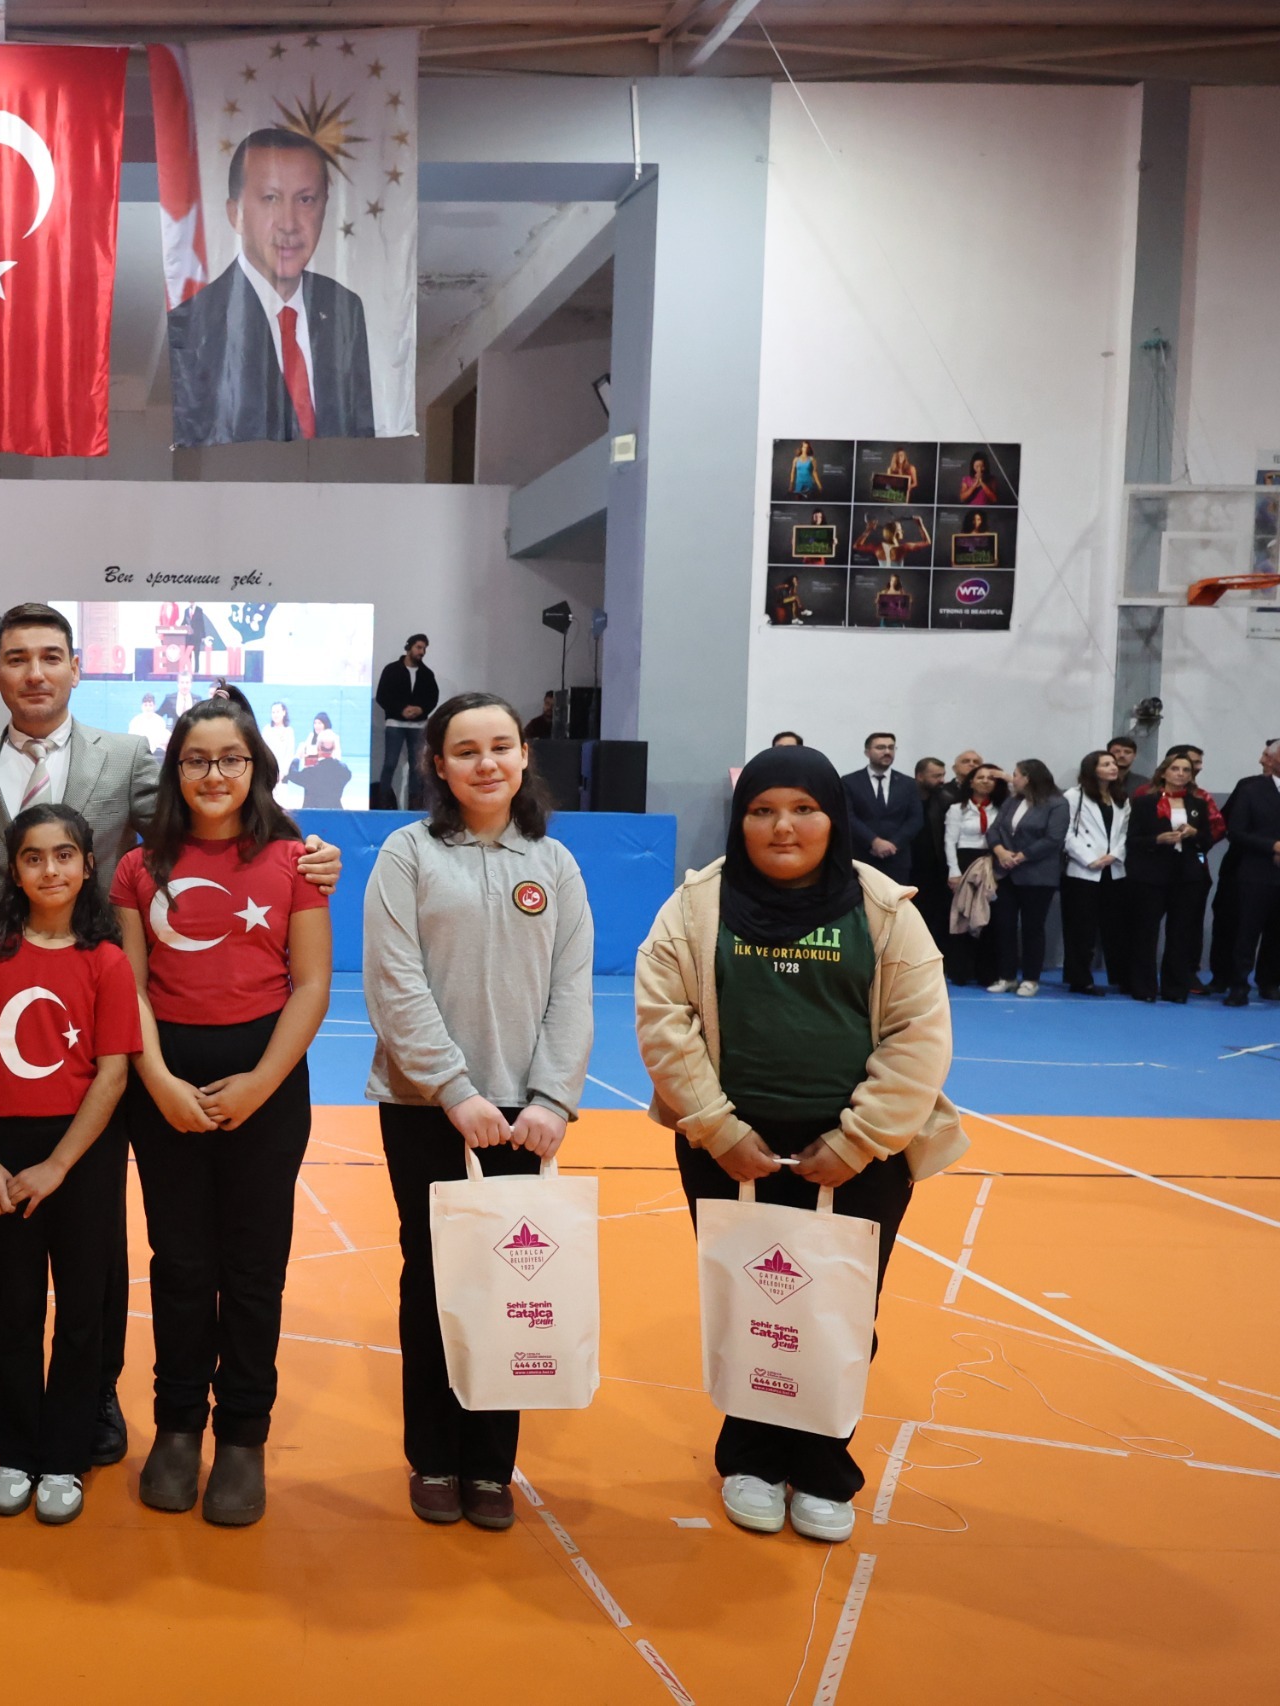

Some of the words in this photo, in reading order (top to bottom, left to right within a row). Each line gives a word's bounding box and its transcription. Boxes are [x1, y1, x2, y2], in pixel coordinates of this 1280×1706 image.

[104, 566, 133, 583] Ben
[146, 571, 220, 588] sporcunun
[959, 586, 986, 596] WTA
[971, 608, 1004, 616] BEAUTIFUL
[734, 942, 751, 955] İLK
[756, 945, 768, 957] VE
[772, 947, 840, 962] ORTAOKULU
[773, 961, 800, 973] 1928
[754, 1377, 770, 1385] 444
[772, 1380, 782, 1388] 61
[783, 1382, 795, 1390] 02
